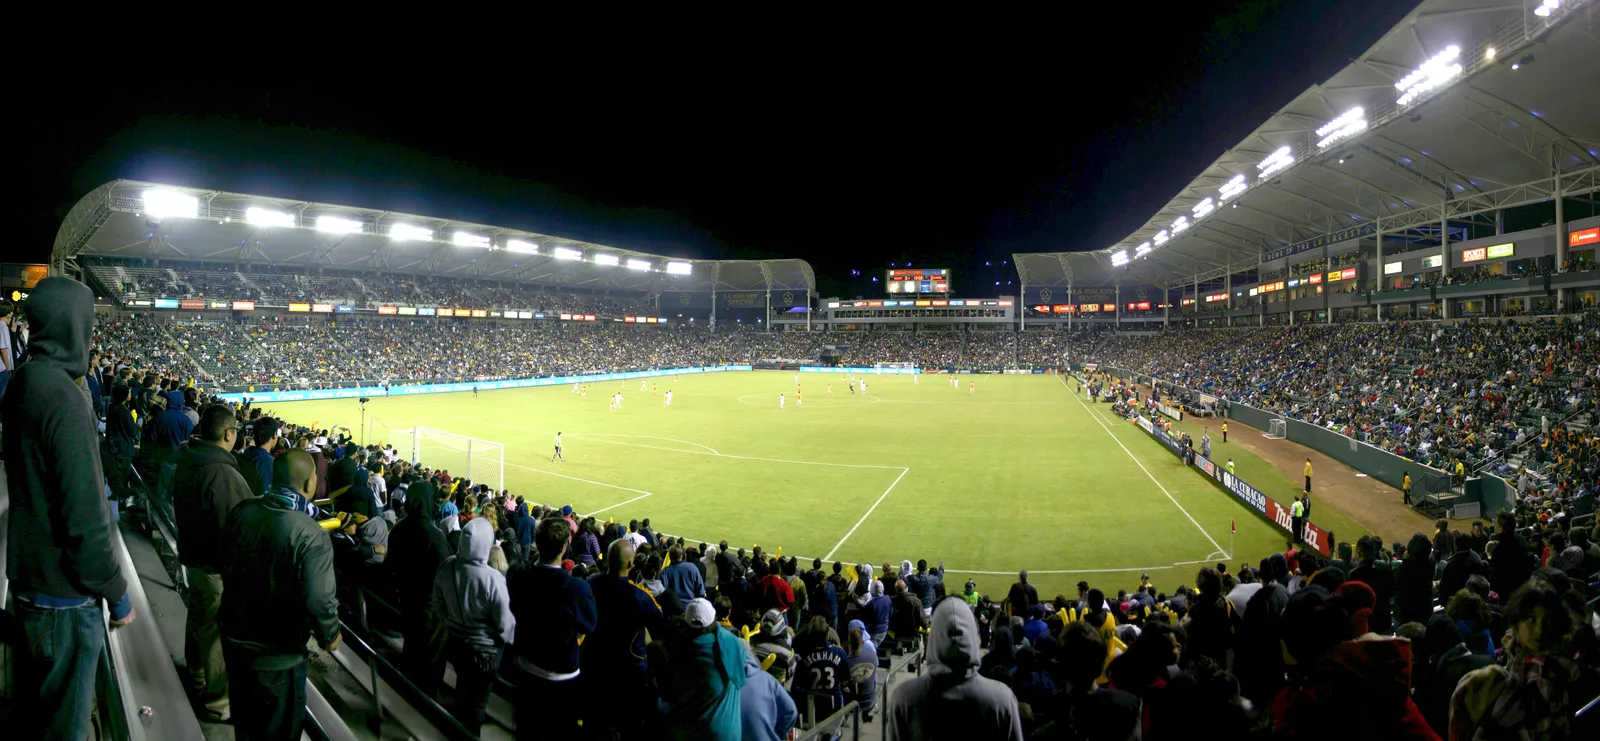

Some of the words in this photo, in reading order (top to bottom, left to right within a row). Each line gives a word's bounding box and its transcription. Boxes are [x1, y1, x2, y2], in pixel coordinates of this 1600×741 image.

[1297, 242, 1310, 252] THE
[1313, 237, 1322, 247] LA
[1326, 228, 1361, 244] GALAXY
[1231, 476, 1238, 489] LA
[1239, 481, 1266, 507] CURACAO
[804, 651, 841, 666] BECKHAM
[811, 666, 835, 689] 23
